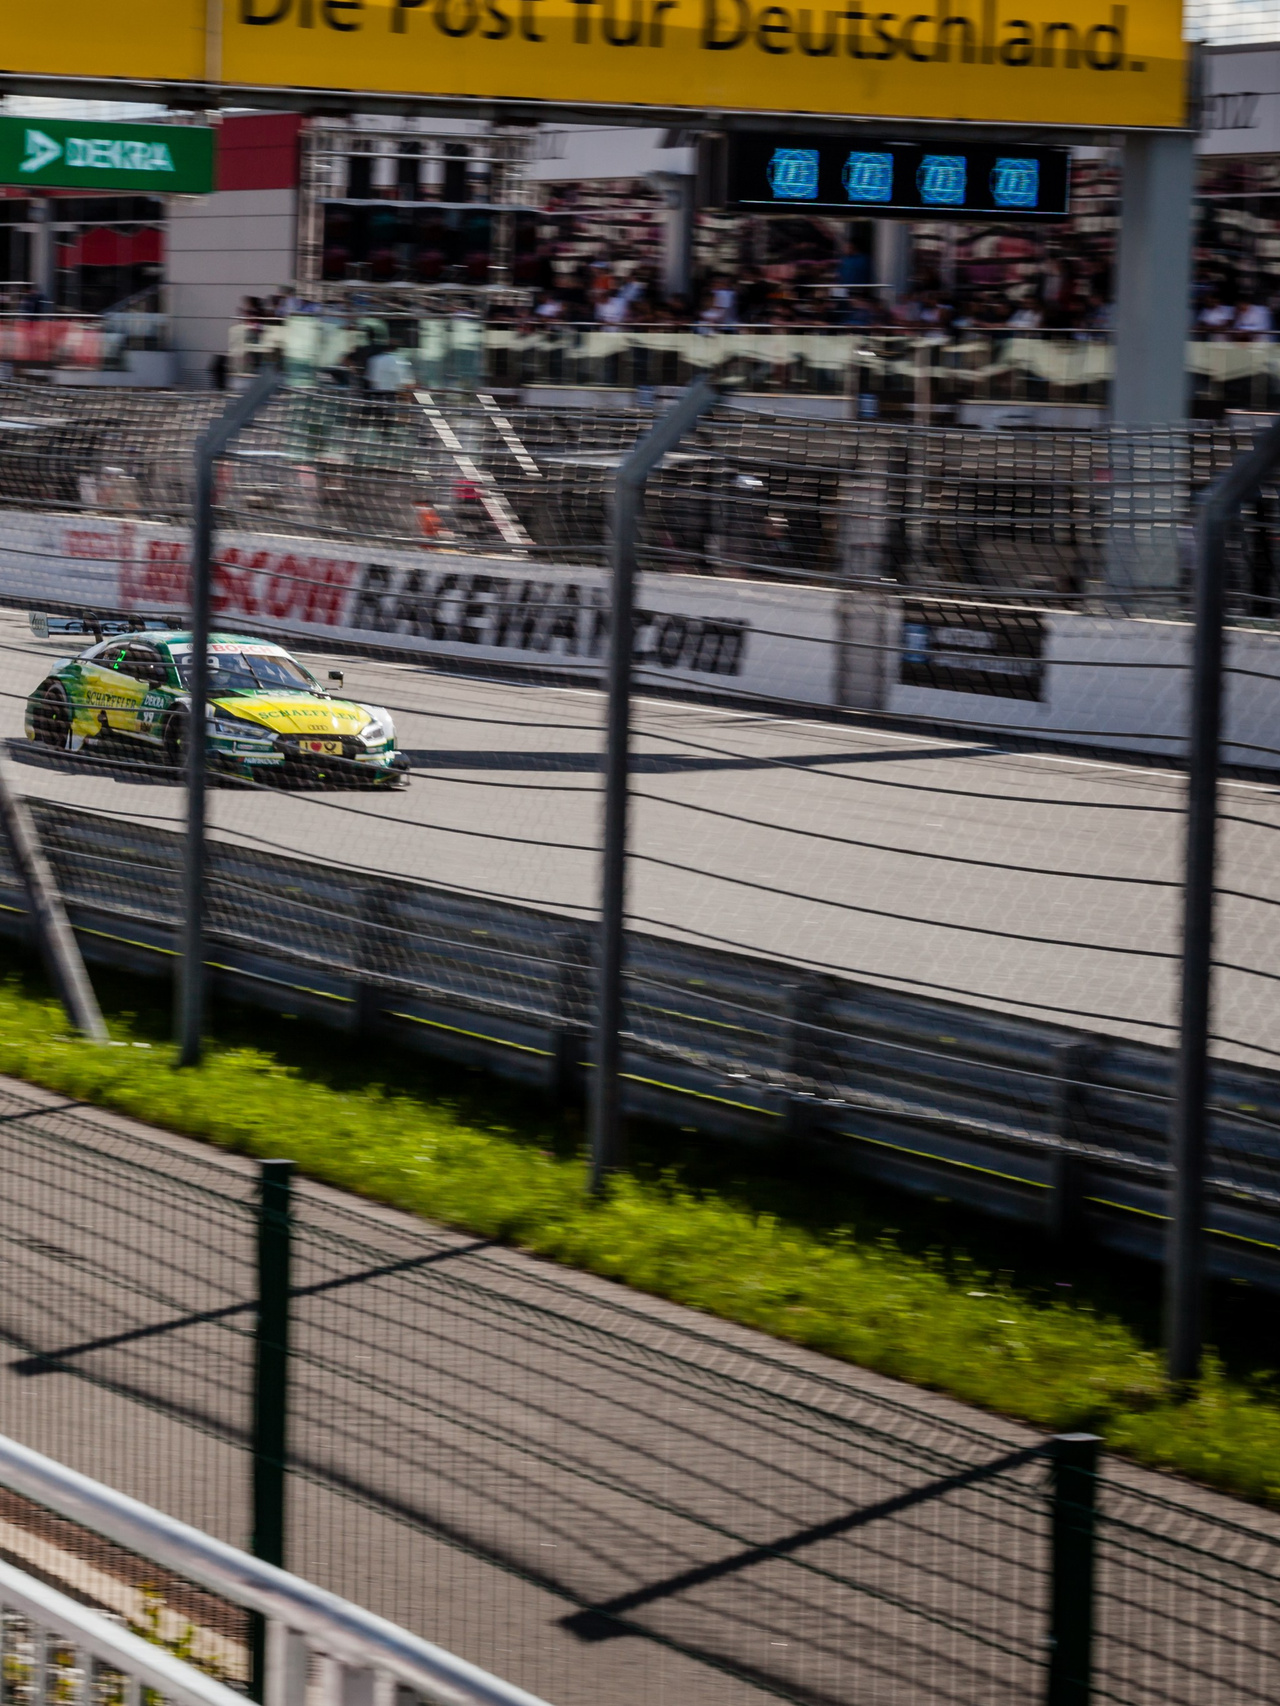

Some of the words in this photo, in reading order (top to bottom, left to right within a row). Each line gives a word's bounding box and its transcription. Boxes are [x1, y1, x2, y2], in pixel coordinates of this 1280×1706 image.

[65, 138, 176, 171] DEKRA
[131, 540, 358, 627] MSCOW
[212, 644, 274, 654] BOSCH
[86, 689, 138, 713] SCHAEFFLER
[144, 694, 165, 709] DEKRA
[258, 708, 360, 722] SCHAEFFLER
